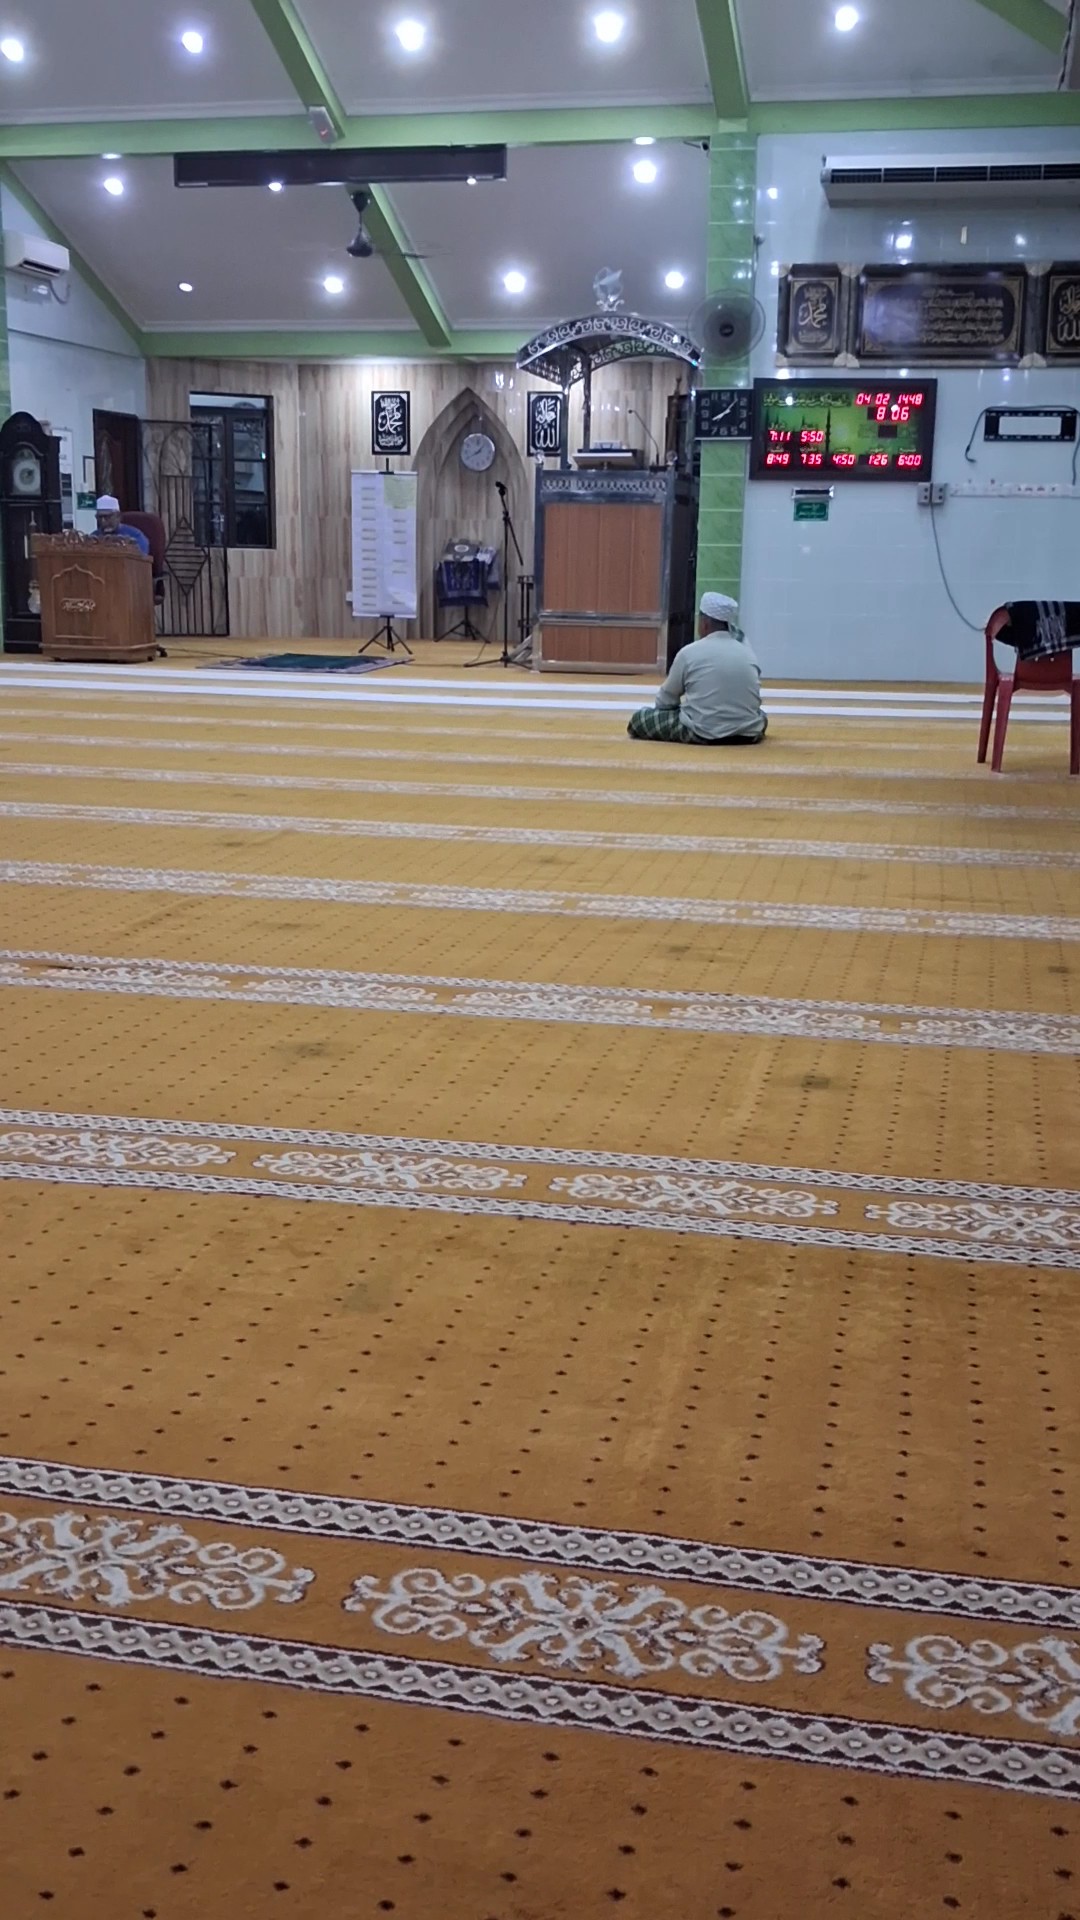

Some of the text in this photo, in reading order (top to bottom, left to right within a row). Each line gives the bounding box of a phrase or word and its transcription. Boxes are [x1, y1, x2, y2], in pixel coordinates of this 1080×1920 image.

[856, 393, 871, 405] 04
[875, 393, 890, 405] 02
[898, 393, 923, 405] 1448
[876, 406, 910, 420] 8 06
[711, 426, 718, 435] 7
[720, 427, 728, 436] 6
[730, 426, 738, 435] 5
[739, 421, 746, 430] 4
[801, 430, 824, 442] 5:50
[766, 453, 790, 465] 8:49
[832, 454, 856, 465] 4:50
[868, 454, 888, 466] 1:26
[897, 454, 922, 466] 6:00
